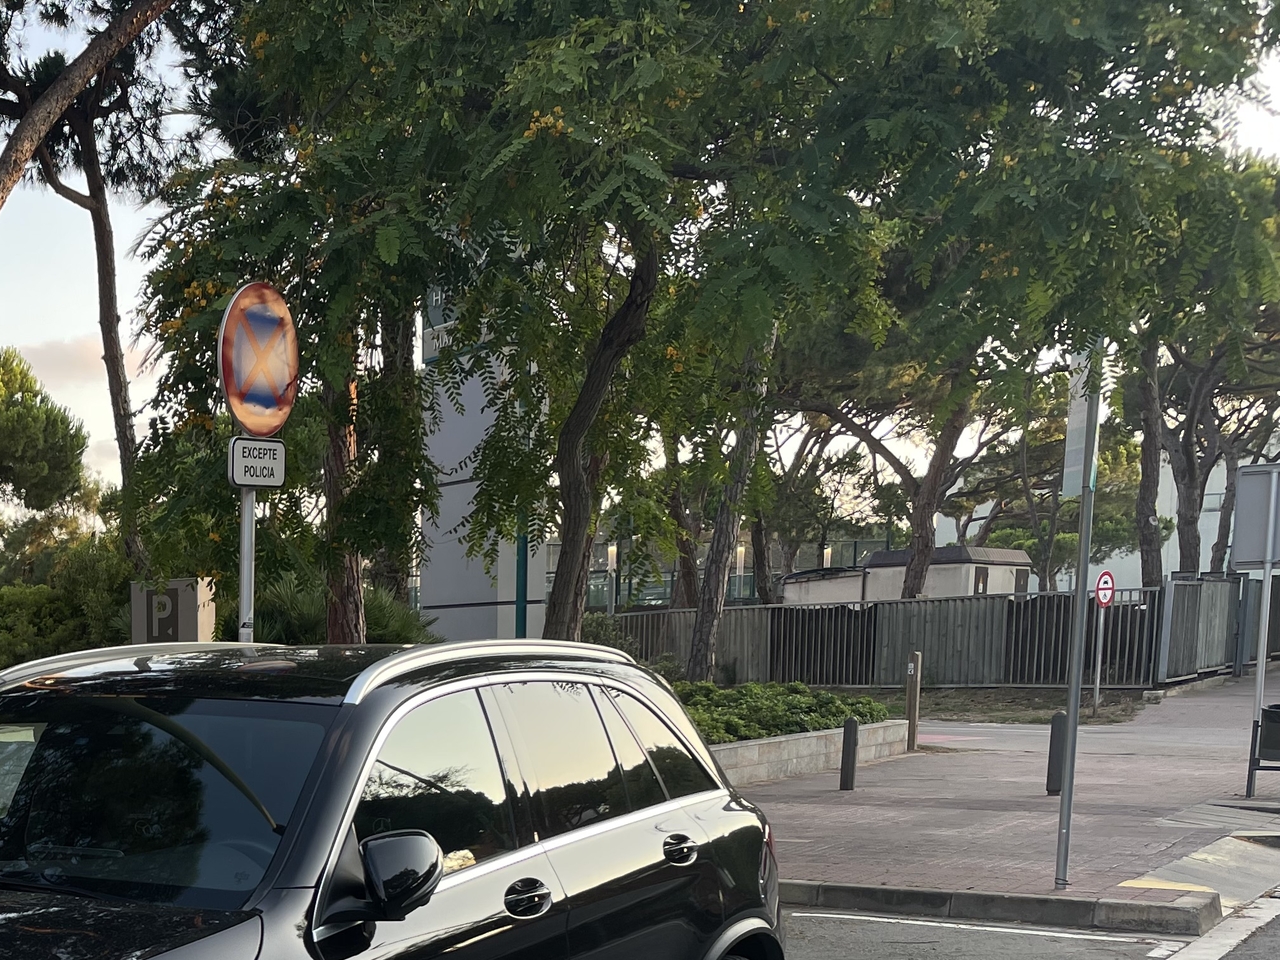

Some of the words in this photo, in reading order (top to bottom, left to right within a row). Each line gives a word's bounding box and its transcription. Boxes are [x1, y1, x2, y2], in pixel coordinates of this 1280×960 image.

[242, 446, 277, 460] EXCEPTE
[244, 464, 275, 479] POLICIA
[152, 594, 173, 637] P
